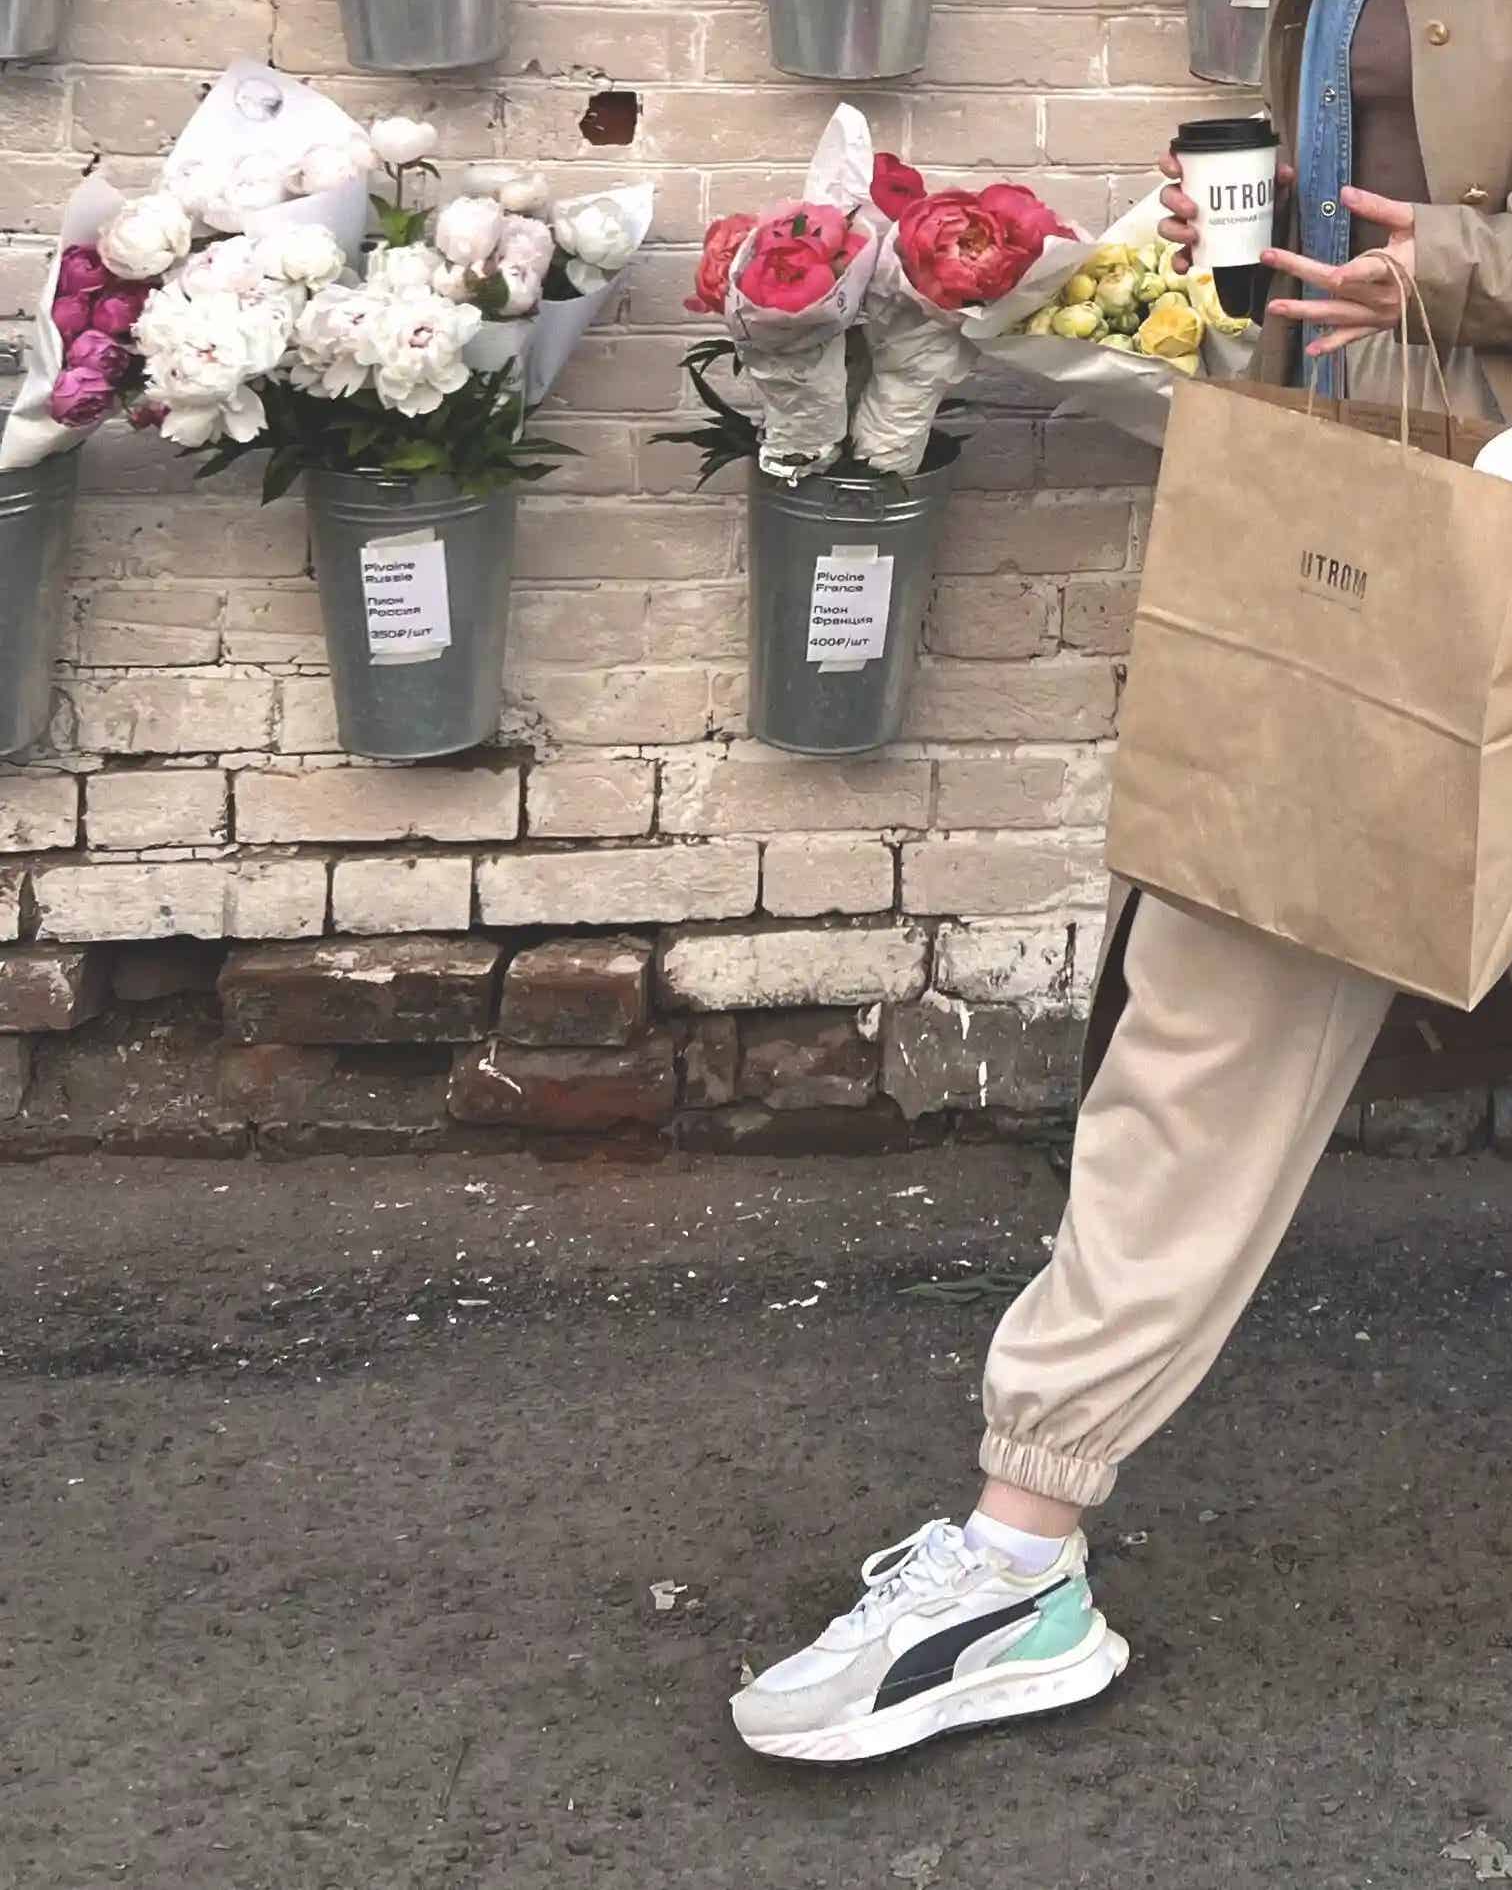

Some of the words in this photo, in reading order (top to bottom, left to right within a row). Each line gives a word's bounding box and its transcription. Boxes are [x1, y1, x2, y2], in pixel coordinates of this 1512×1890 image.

[364, 562, 415, 572] Pivoine
[365, 573, 413, 583] Russie
[817, 572, 865, 582] Pivoine
[1300, 550, 1368, 600] UTROM
[816, 583, 864, 592] France
[369, 607, 421, 617] Россия
[814, 605, 848, 614] Пион
[812, 616, 873, 626] Франция
